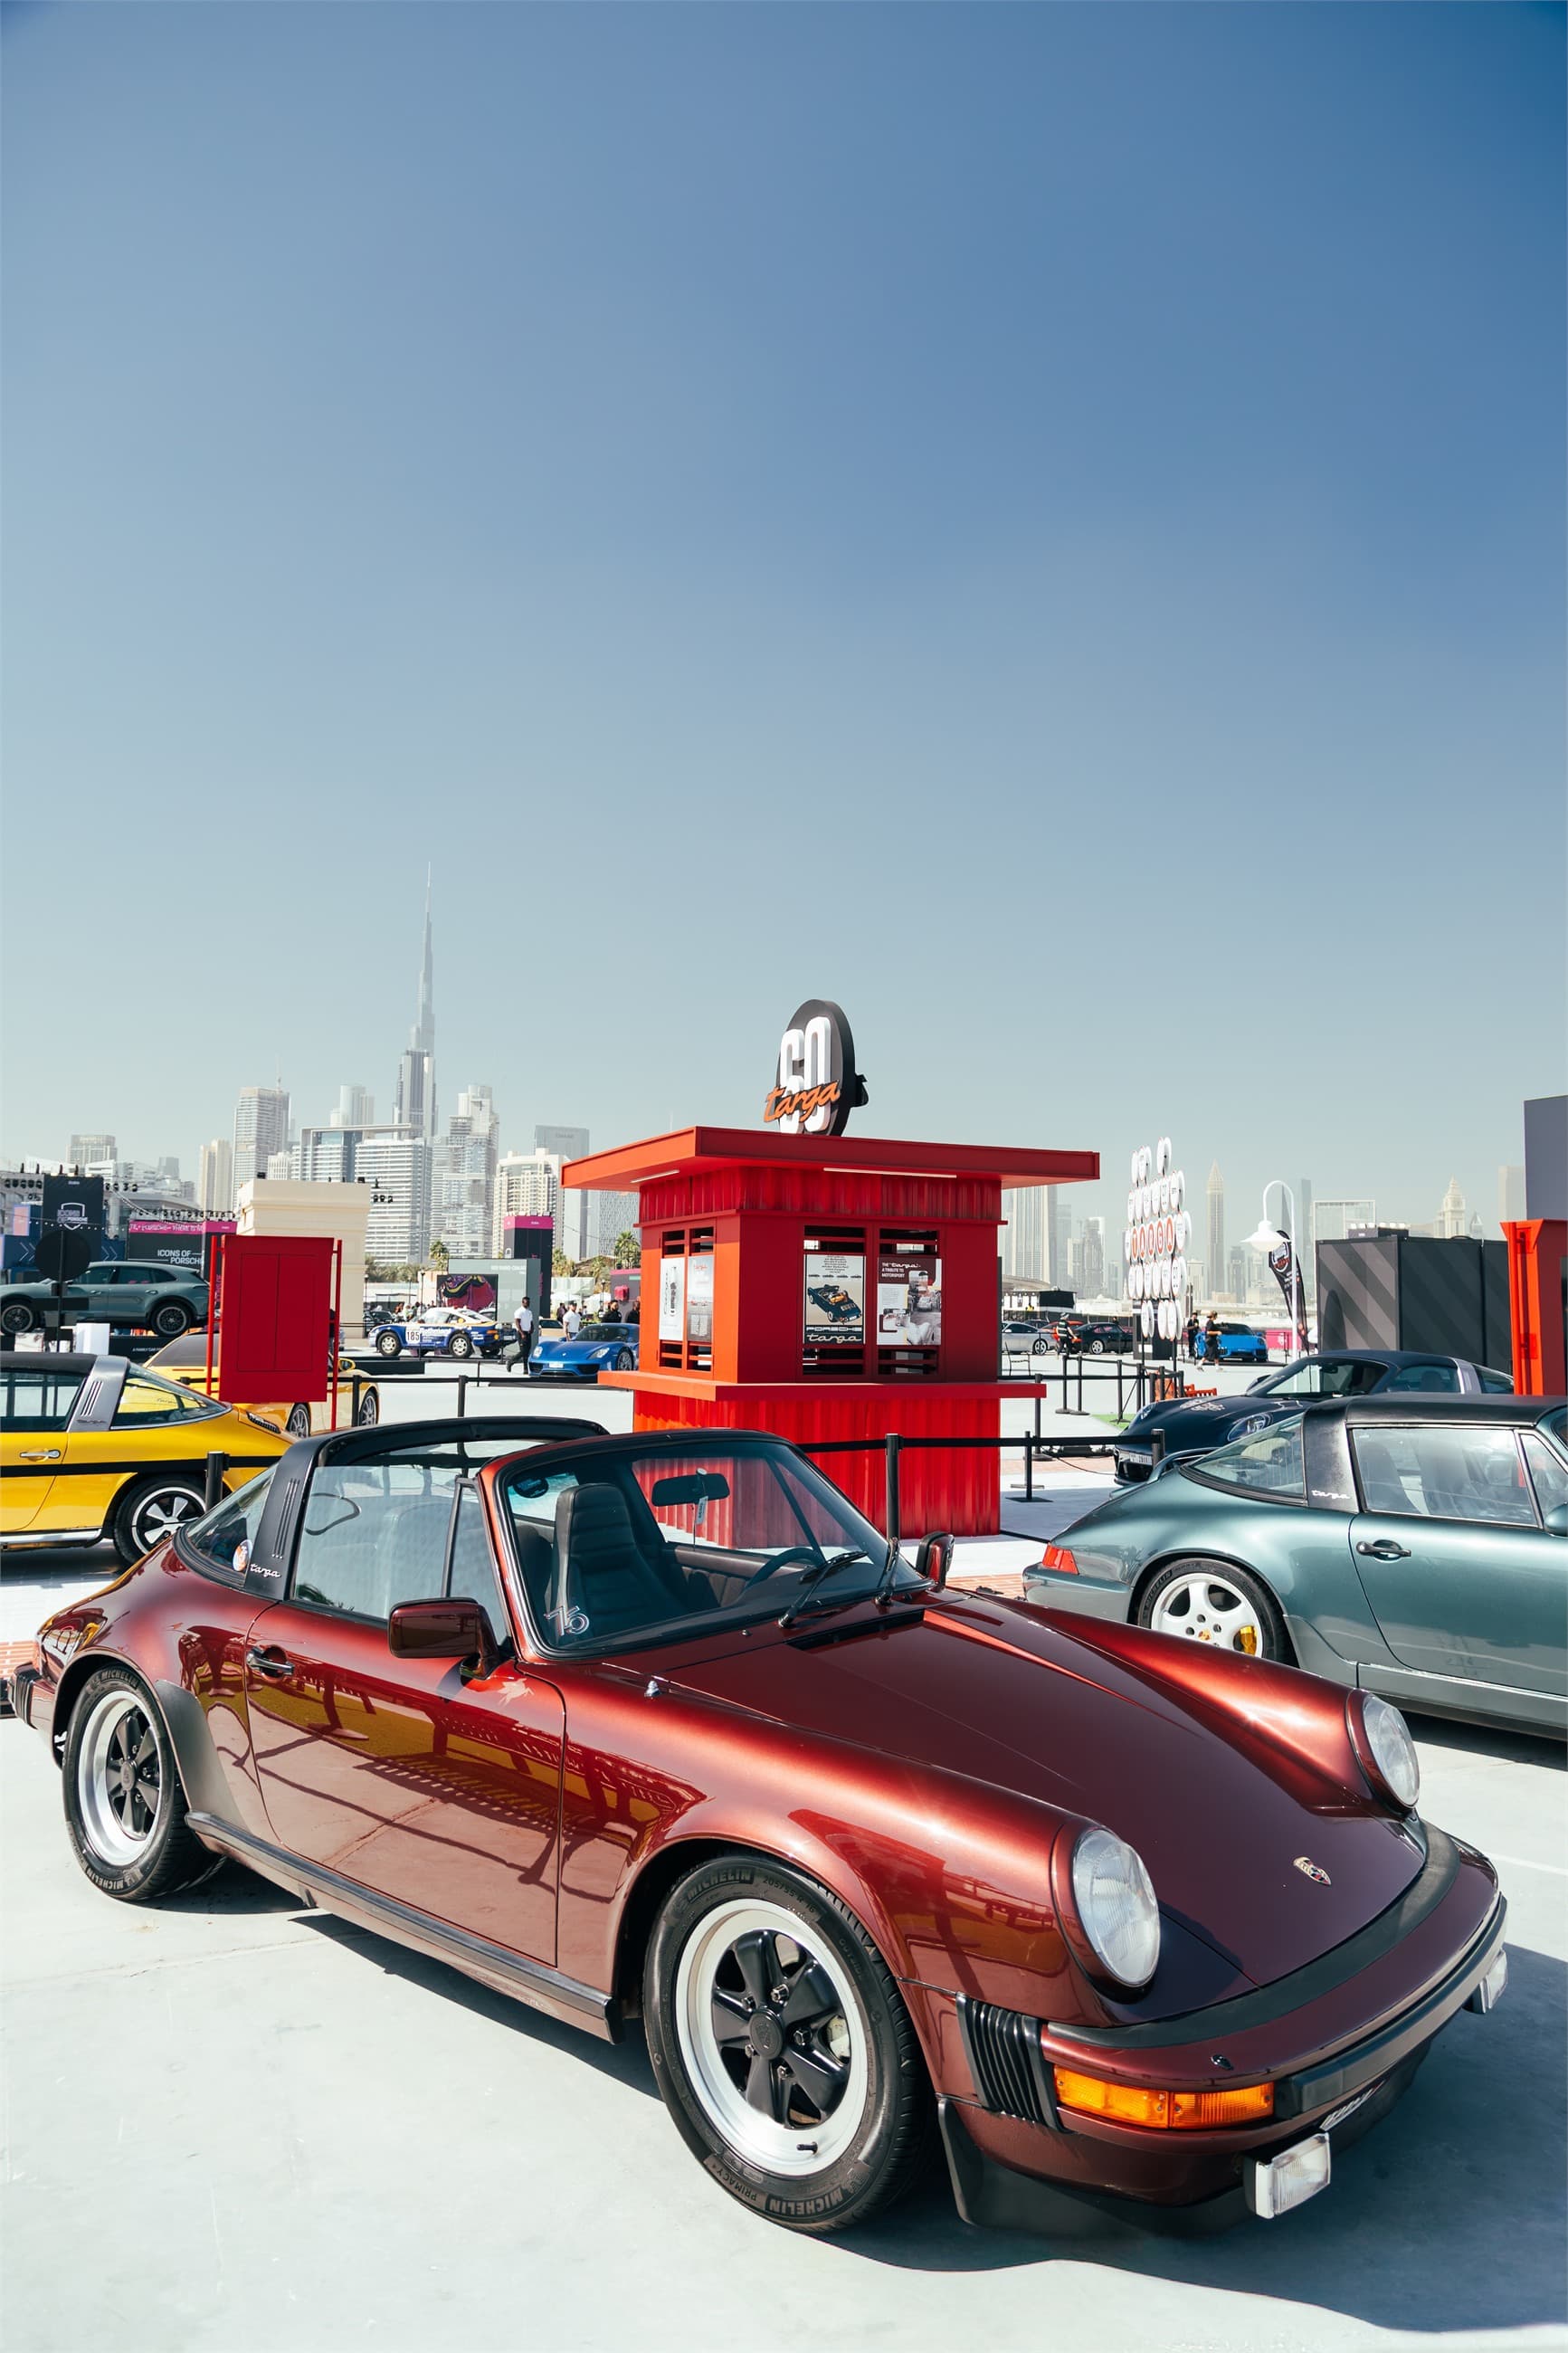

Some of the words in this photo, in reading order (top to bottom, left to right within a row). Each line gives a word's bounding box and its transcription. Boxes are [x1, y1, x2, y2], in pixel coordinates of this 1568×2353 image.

[764, 1080, 841, 1123] targa
[406, 1330, 420, 1341] 185
[806, 1332, 862, 1344] targa
[1310, 1490, 1351, 1500] targa
[250, 1563, 281, 1577] targa
[100, 1669, 138, 1689] MICHELIN
[86, 1866, 124, 1891] MICHELIN
[687, 1868, 752, 1901] MICHELIN
[717, 2168, 758, 2203] PRIMACY
[769, 2187, 844, 2216] MICHELIN
